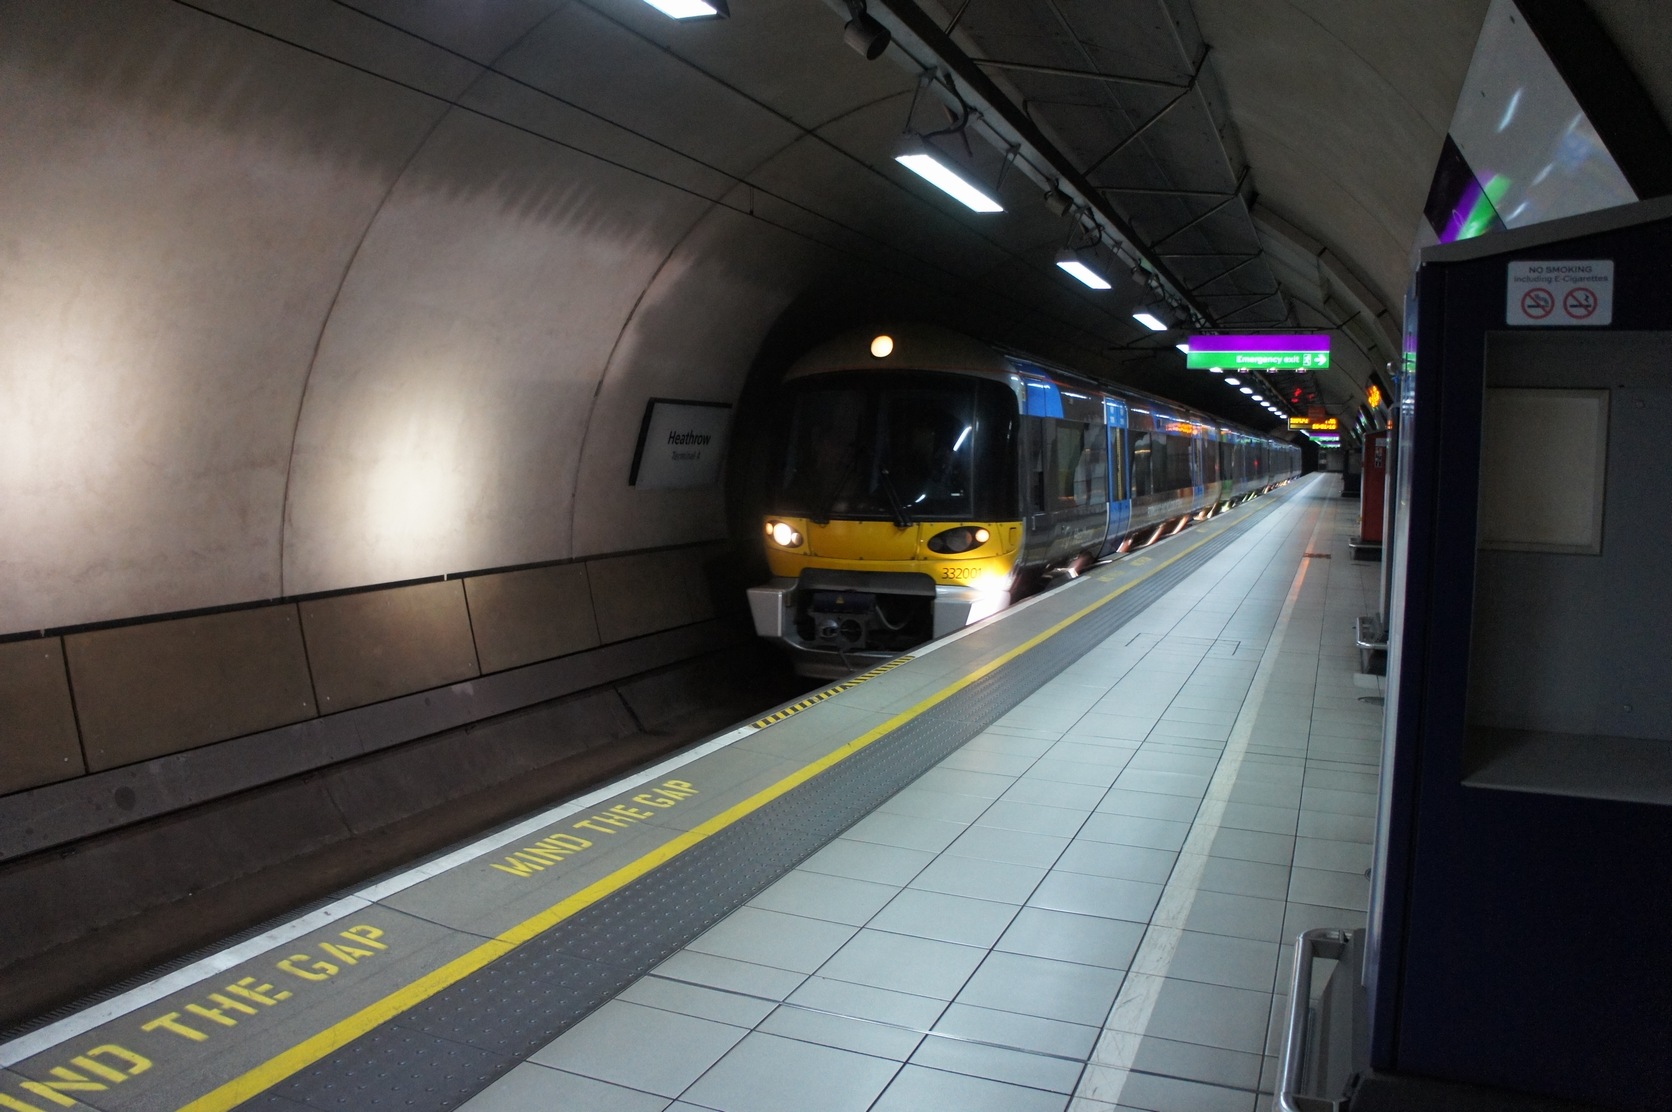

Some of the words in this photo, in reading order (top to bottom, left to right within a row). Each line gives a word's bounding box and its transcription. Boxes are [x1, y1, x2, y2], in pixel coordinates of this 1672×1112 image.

[1529, 266, 1544, 274] NO
[1545, 265, 1592, 274] SMOKING
[1554, 274, 1608, 284] E-Cigarettes
[1236, 355, 1282, 364] Emergency
[1283, 355, 1299, 363] exit
[667, 429, 711, 445] Heathrow
[489, 833, 592, 878] MIND
[573, 804, 654, 834] THE
[633, 779, 700, 808] GAP
[141, 975, 293, 1042] THE
[276, 924, 389, 981] GAP
